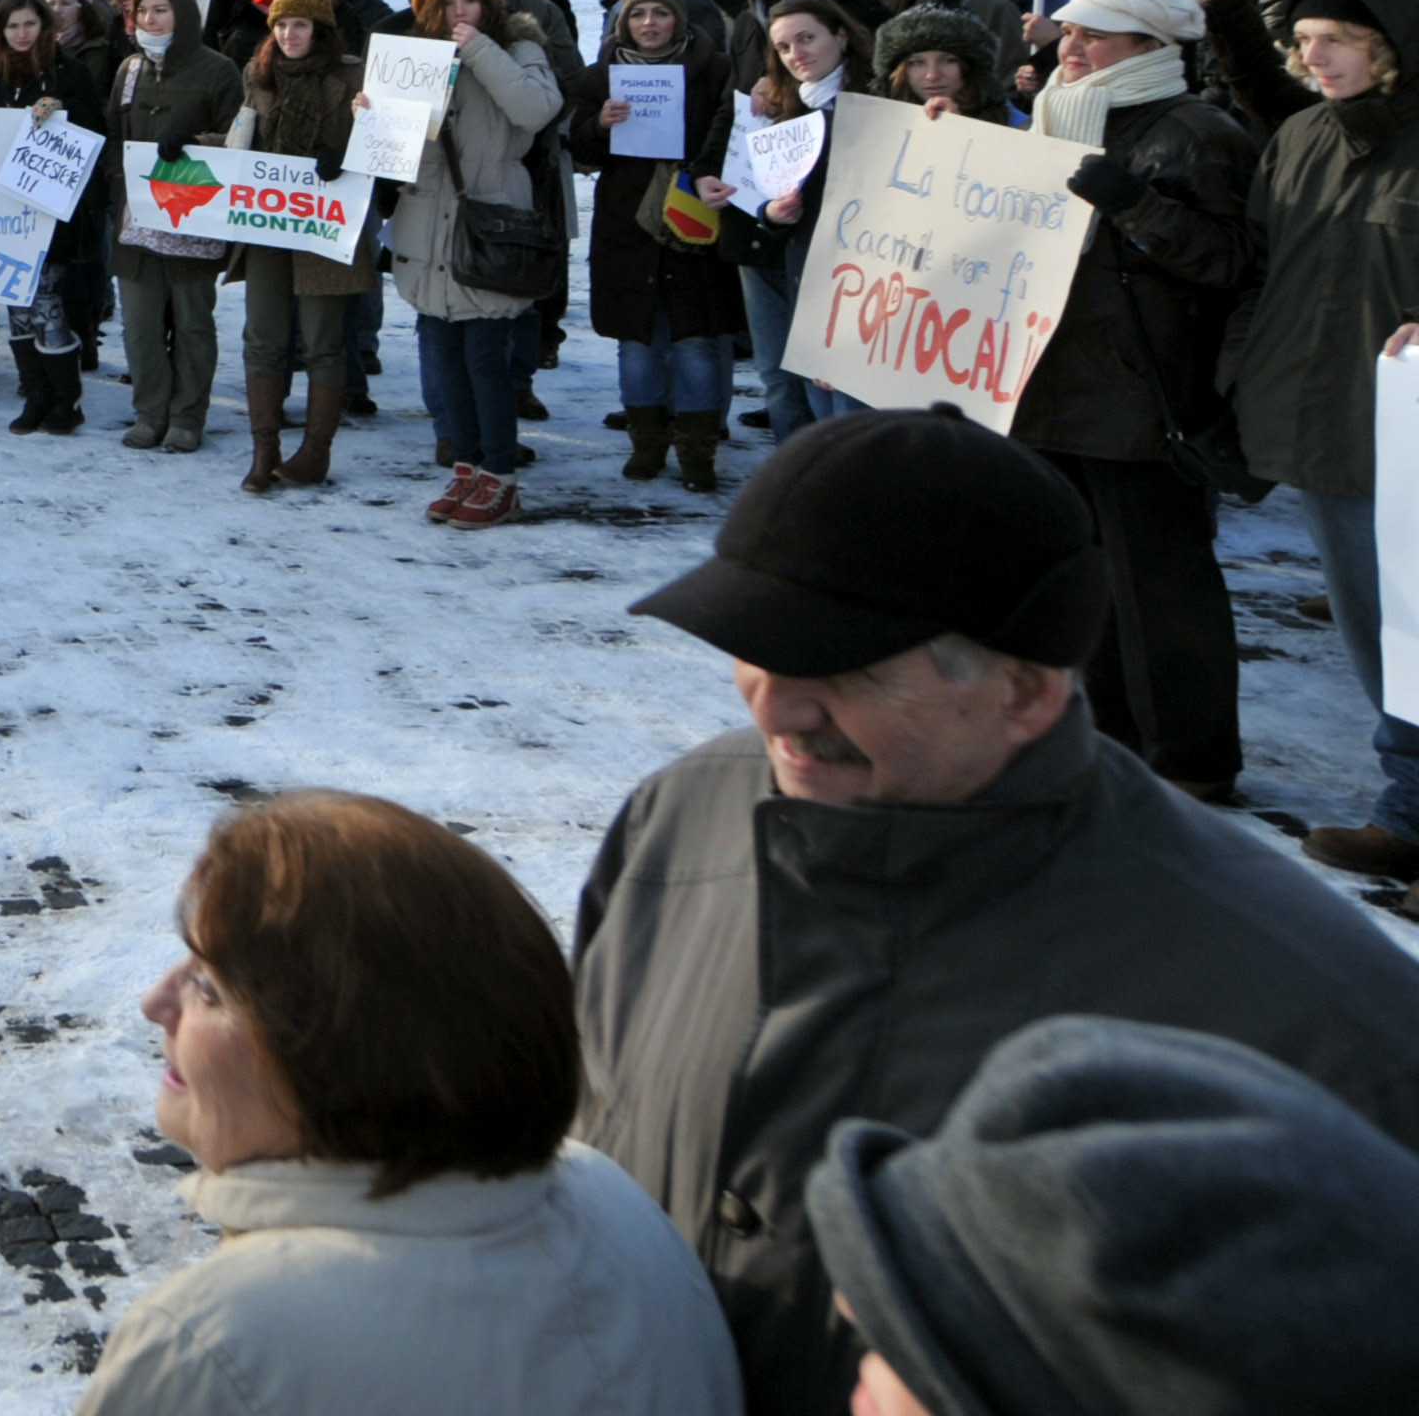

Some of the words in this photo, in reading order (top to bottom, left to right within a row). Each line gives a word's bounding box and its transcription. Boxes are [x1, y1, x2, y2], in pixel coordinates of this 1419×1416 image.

[368, 51, 396, 85] NU
[396, 56, 449, 91] DORM
[886, 129, 935, 199] La
[952, 139, 1069, 232] toamnă
[229, 183, 346, 225] ROSIA
[226, 209, 341, 243] MONTANA
[951, 252, 991, 285] vor
[994, 250, 1035, 324] fi
